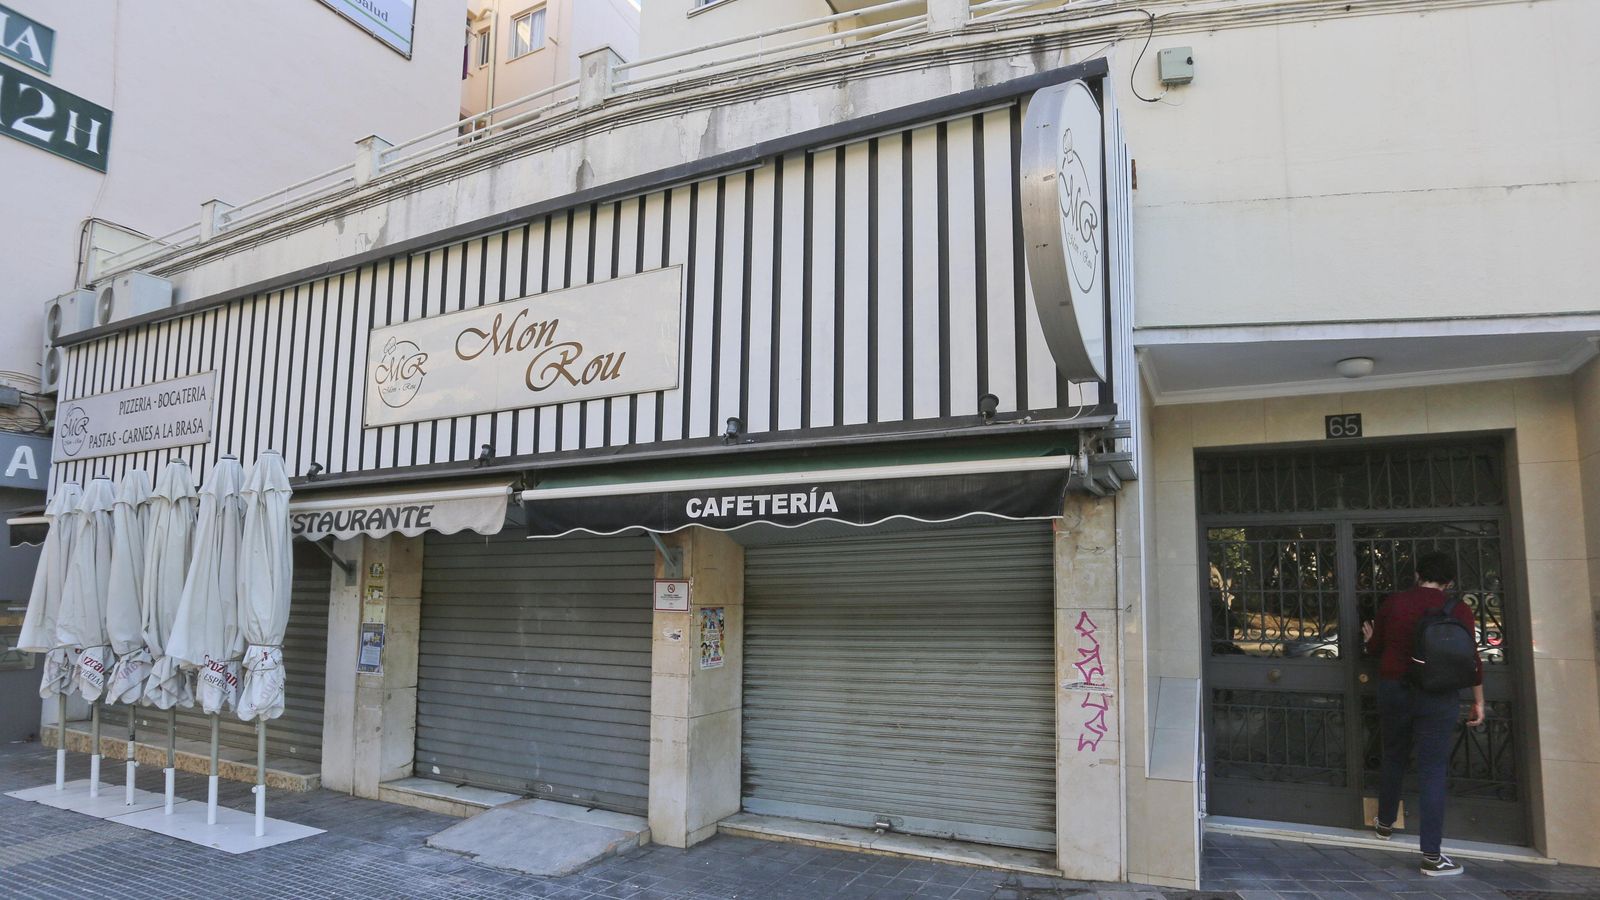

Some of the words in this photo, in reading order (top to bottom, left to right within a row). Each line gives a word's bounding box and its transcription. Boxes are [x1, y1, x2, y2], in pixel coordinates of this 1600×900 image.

[0, 76, 102, 155] 2H
[455, 308, 559, 361] Mon
[375, 352, 428, 385] MR
[525, 341, 626, 392] Rou
[118, 396, 152, 416] PIZZERIA
[157, 386, 206, 409] BOCATERIA
[89, 431, 117, 449] PASTAS
[122, 425, 153, 445] CARNES
[153, 425, 160, 440] A
[162, 423, 174, 439] LA
[175, 417, 204, 437] BRASA
[1329, 415, 1359, 437] 65
[4, 445, 39, 480] A
[685, 487, 839, 518] CAFETERÍA
[290, 505, 435, 534] STAURANTE
